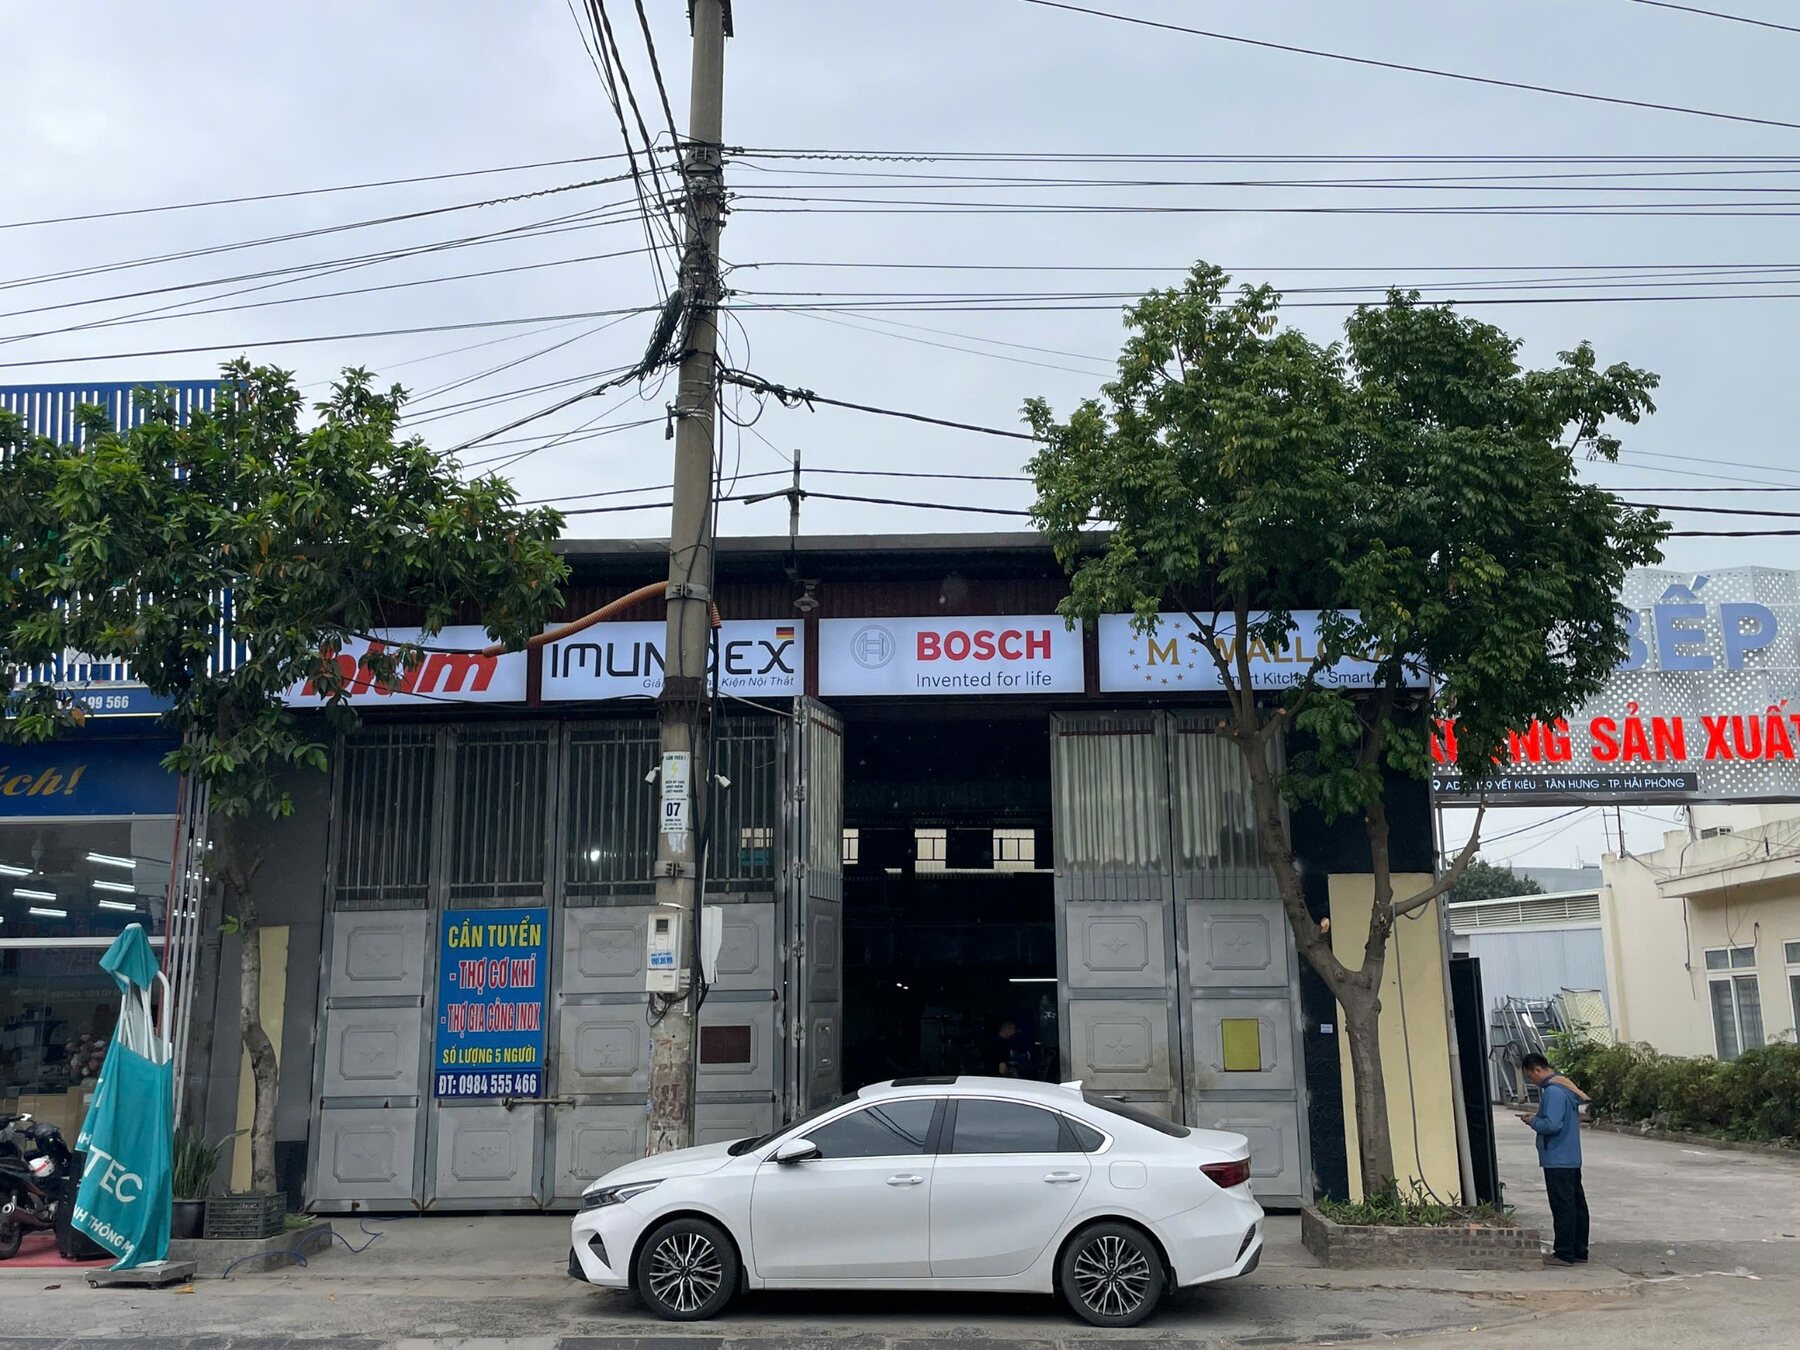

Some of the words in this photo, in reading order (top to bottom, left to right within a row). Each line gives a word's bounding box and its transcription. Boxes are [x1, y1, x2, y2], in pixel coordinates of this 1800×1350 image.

[551, 639, 795, 678] IMUNEX
[916, 630, 1051, 661] BOSCH
[1215, 636, 1396, 664] WALL
[721, 677, 745, 687] Kiện
[749, 677, 768, 688] Nội
[770, 675, 795, 686] Thất
[916, 672, 991, 687] Invented
[996, 671, 1021, 687] for
[1025, 671, 1051, 686] life
[1217, 673, 1259, 685] Smrt
[1263, 672, 1311, 685] Kitche
[1328, 671, 1371, 684] Smart
[105, 695, 129, 709] 566
[1589, 701, 1687, 763] SẢN
[1494, 778, 1512, 790] YẾT
[1545, 778, 1566, 789] TÂN
[1568, 778, 1600, 789] HƯNG
[1608, 779, 1622, 789] TP.
[1624, 776, 1642, 788] HẢI
[1645, 777, 1685, 788] PHÒNG
[666, 802, 681, 817] 07
[448, 917, 484, 949] CẦN
[488, 915, 541, 947] TUYỂN
[459, 956, 488, 995] THỢ
[489, 956, 510, 988] CƠ
[510, 953, 537, 988] KHÍ
[448, 1001, 468, 1038] THỢ
[469, 1003, 485, 1032] GIA
[487, 997, 514, 1032] CÔNG
[515, 1002, 541, 1031] INOX
[442, 1044, 457, 1064] SỐ
[459, 1047, 493, 1066] LƯỢNG
[494, 1047, 501, 1063] 5
[503, 1044, 536, 1063] NGƯỜI
[438, 1075, 456, 1095] ĐT:
[459, 1074, 488, 1094] 0984
[490, 1074, 512, 1094] 555
[515, 1073, 537, 1094] 466
[84, 1144, 143, 1203] TEC
[88, 1215, 125, 1247] THÔNG
